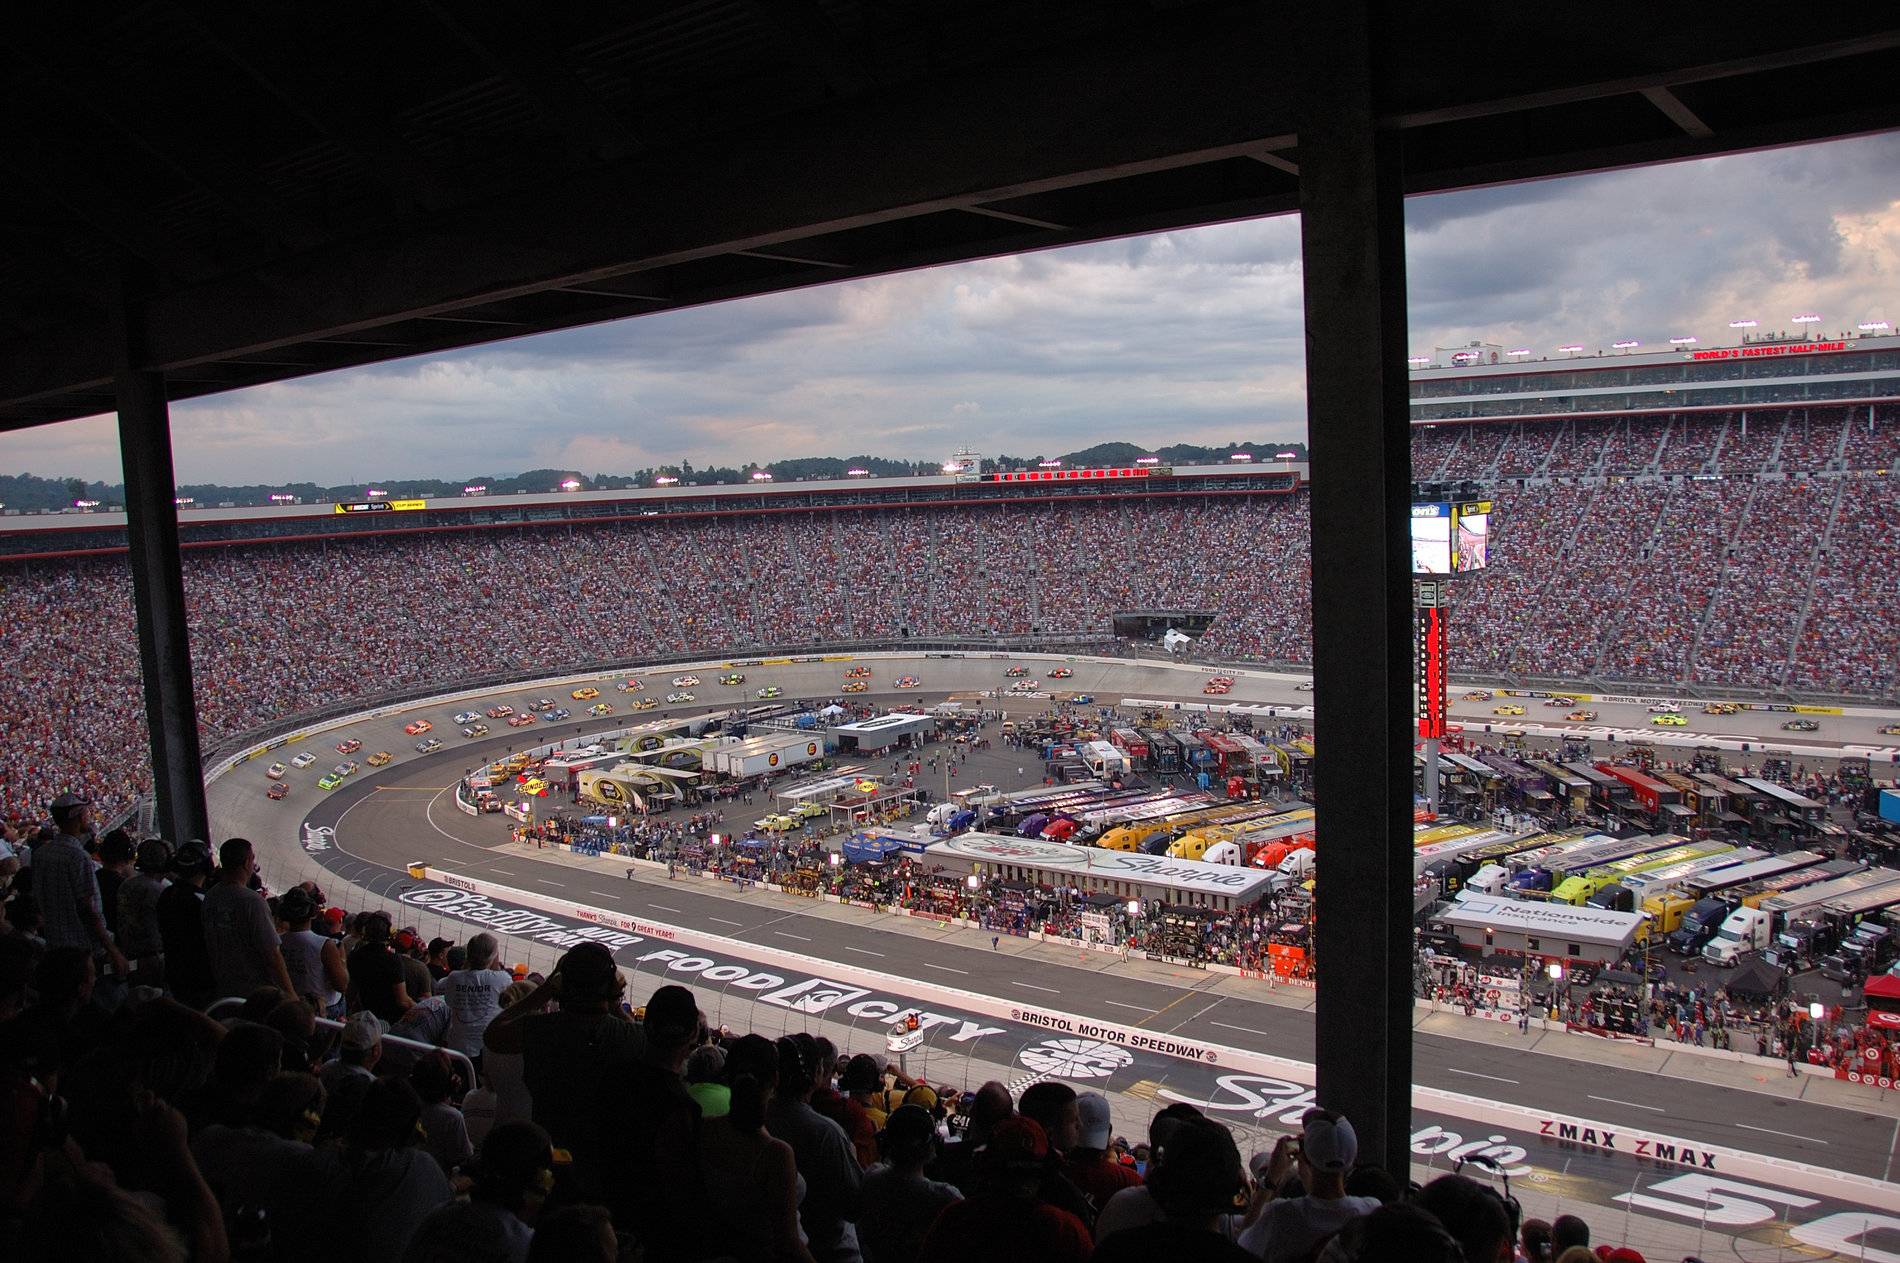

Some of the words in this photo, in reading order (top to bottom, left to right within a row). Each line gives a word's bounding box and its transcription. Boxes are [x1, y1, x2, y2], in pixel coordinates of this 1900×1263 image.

[1693, 350, 1738, 360] WORLD'S
[1743, 346, 1787, 357] FASTEST
[1789, 341, 1845, 353] HALF-MILE
[1608, 696, 1638, 704] BRISTOL
[519, 781, 549, 793] SUNOCO
[1092, 857, 1246, 886] Sharpie
[448, 879, 472, 891] BRISTOL
[576, 910, 597, 921] THANKS
[620, 920, 631, 929] FOR
[631, 921, 637, 932] 9
[637, 924, 654, 934] GREAT
[1497, 911, 1579, 925] Insurance
[1501, 905, 1628, 926] Nationwide
[565, 925, 645, 946] AUTO
[455, 984, 491, 993] SENIOR
[1243, 969, 1260, 978] THE
[1288, 977, 1316, 989] DEPOT
[635, 949, 785, 990] FOOD
[847, 1000, 1007, 1042] CITY
[1021, 1010, 1073, 1032] BRISTOL
[1078, 1023, 1126, 1043] MOTOR
[1130, 1035, 1205, 1060] SPEEDWAY
